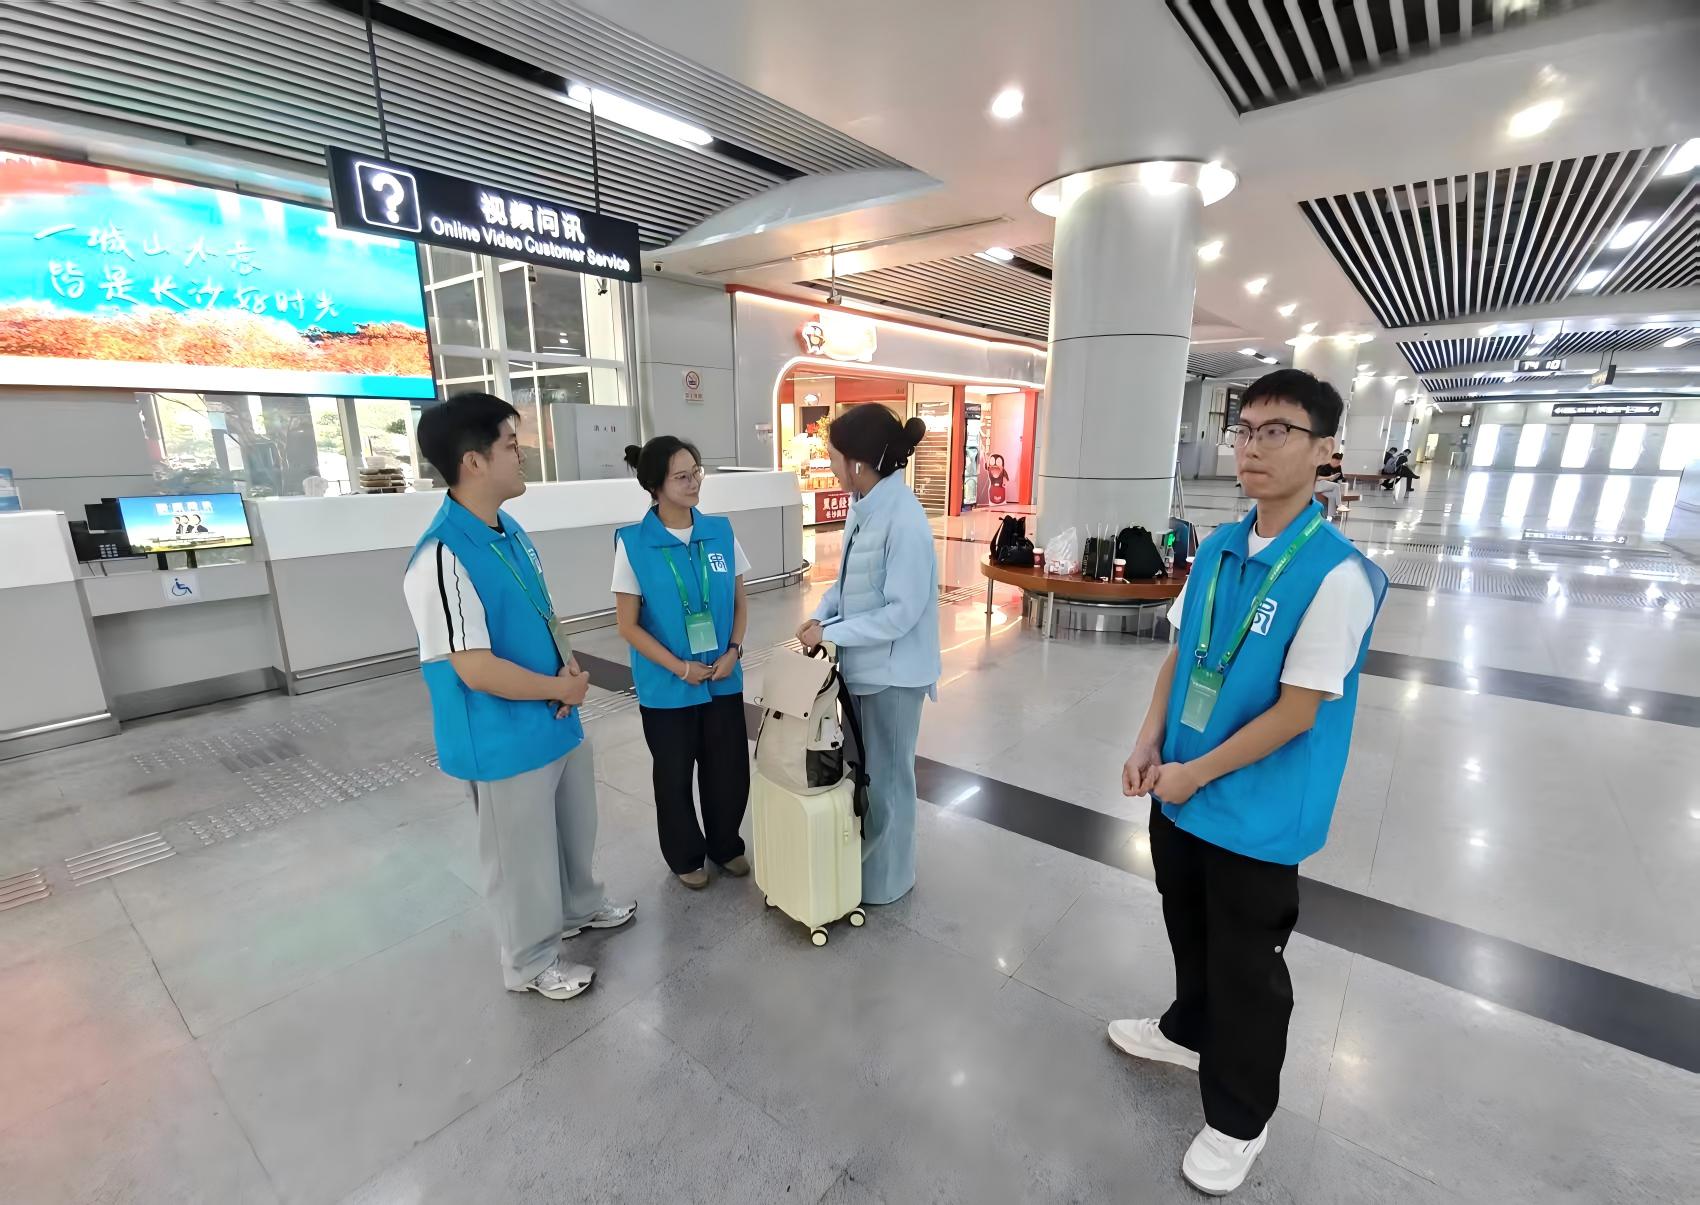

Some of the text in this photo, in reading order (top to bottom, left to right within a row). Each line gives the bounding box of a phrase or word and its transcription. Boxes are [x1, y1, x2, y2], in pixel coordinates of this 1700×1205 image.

[430, 215, 631, 273] Online Video Customer Service
[481, 192, 586, 244] 视频问讯
